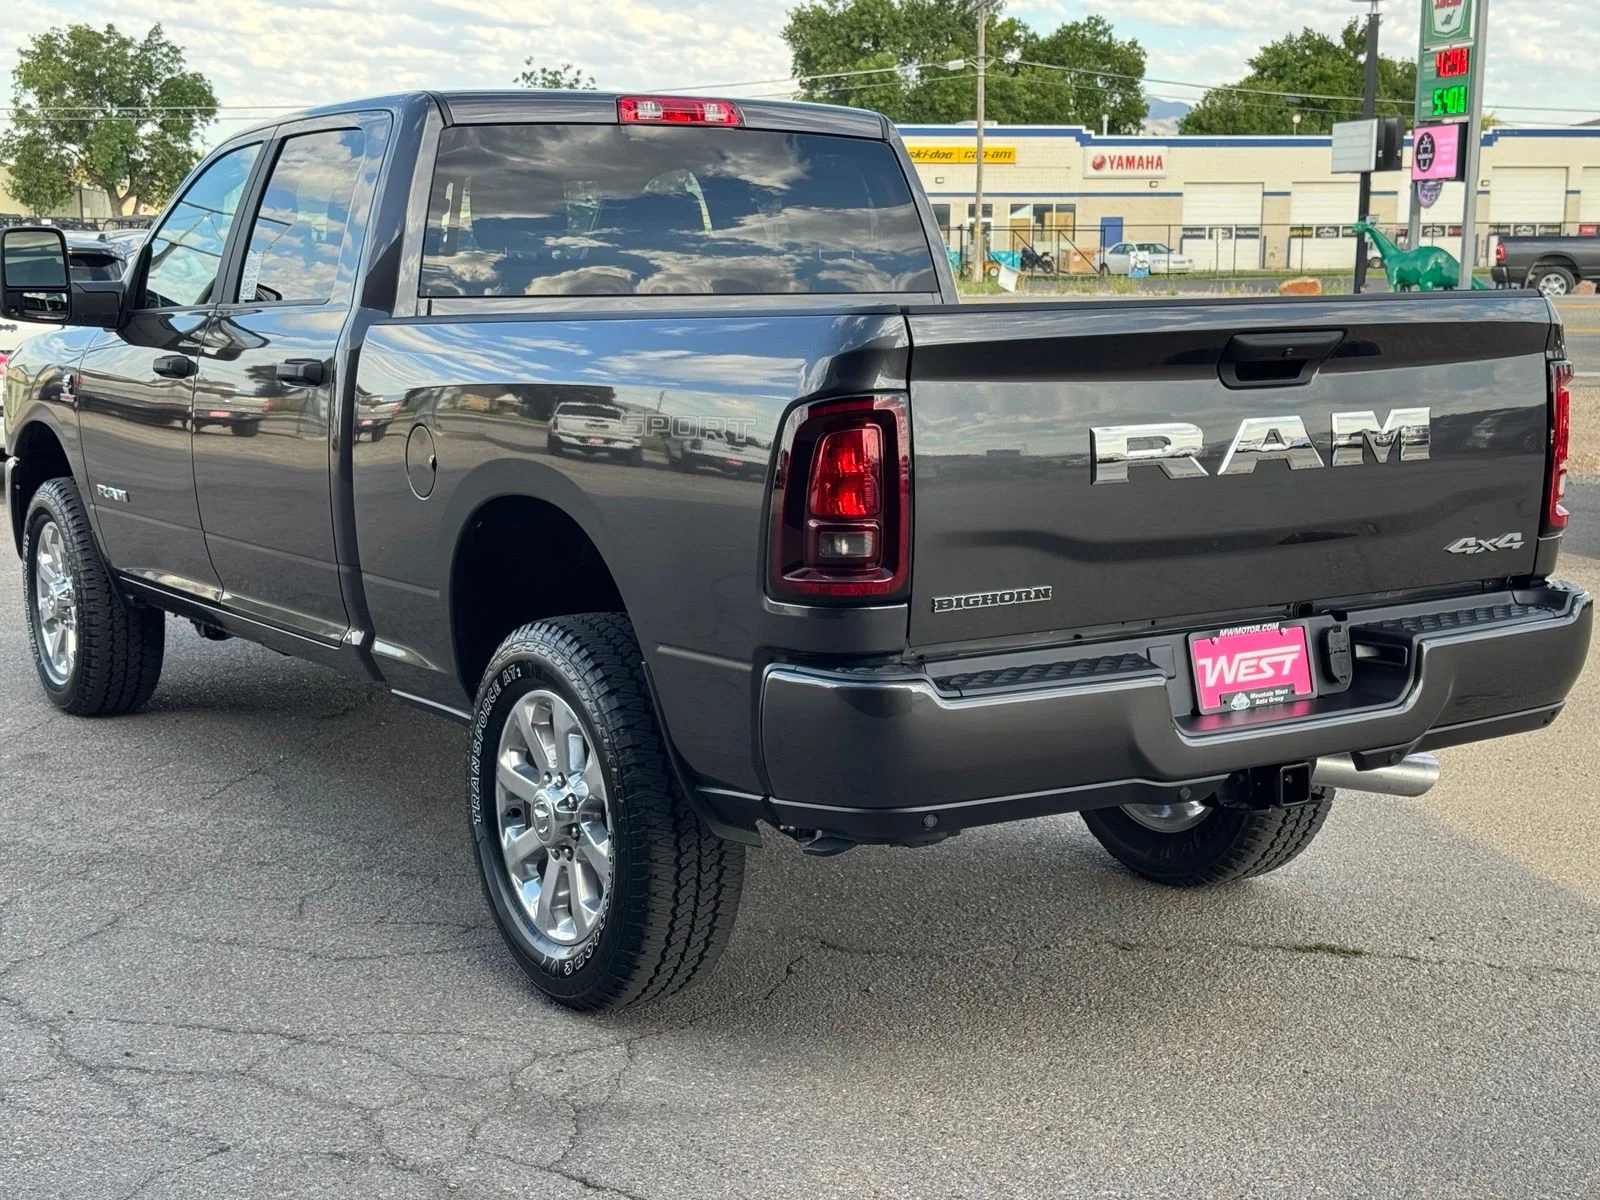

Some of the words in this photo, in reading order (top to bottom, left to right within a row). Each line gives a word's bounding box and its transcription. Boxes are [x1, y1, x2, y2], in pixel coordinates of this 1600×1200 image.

[1108, 154, 1163, 171] YAMAHA
[619, 413, 757, 443] SPORT
[1090, 406, 1431, 485] RAM
[932, 585, 1053, 613] BIGHORN
[1219, 622, 1279, 637] MWMOTOR.COM
[470, 679, 502, 825] TRANSFORCE
